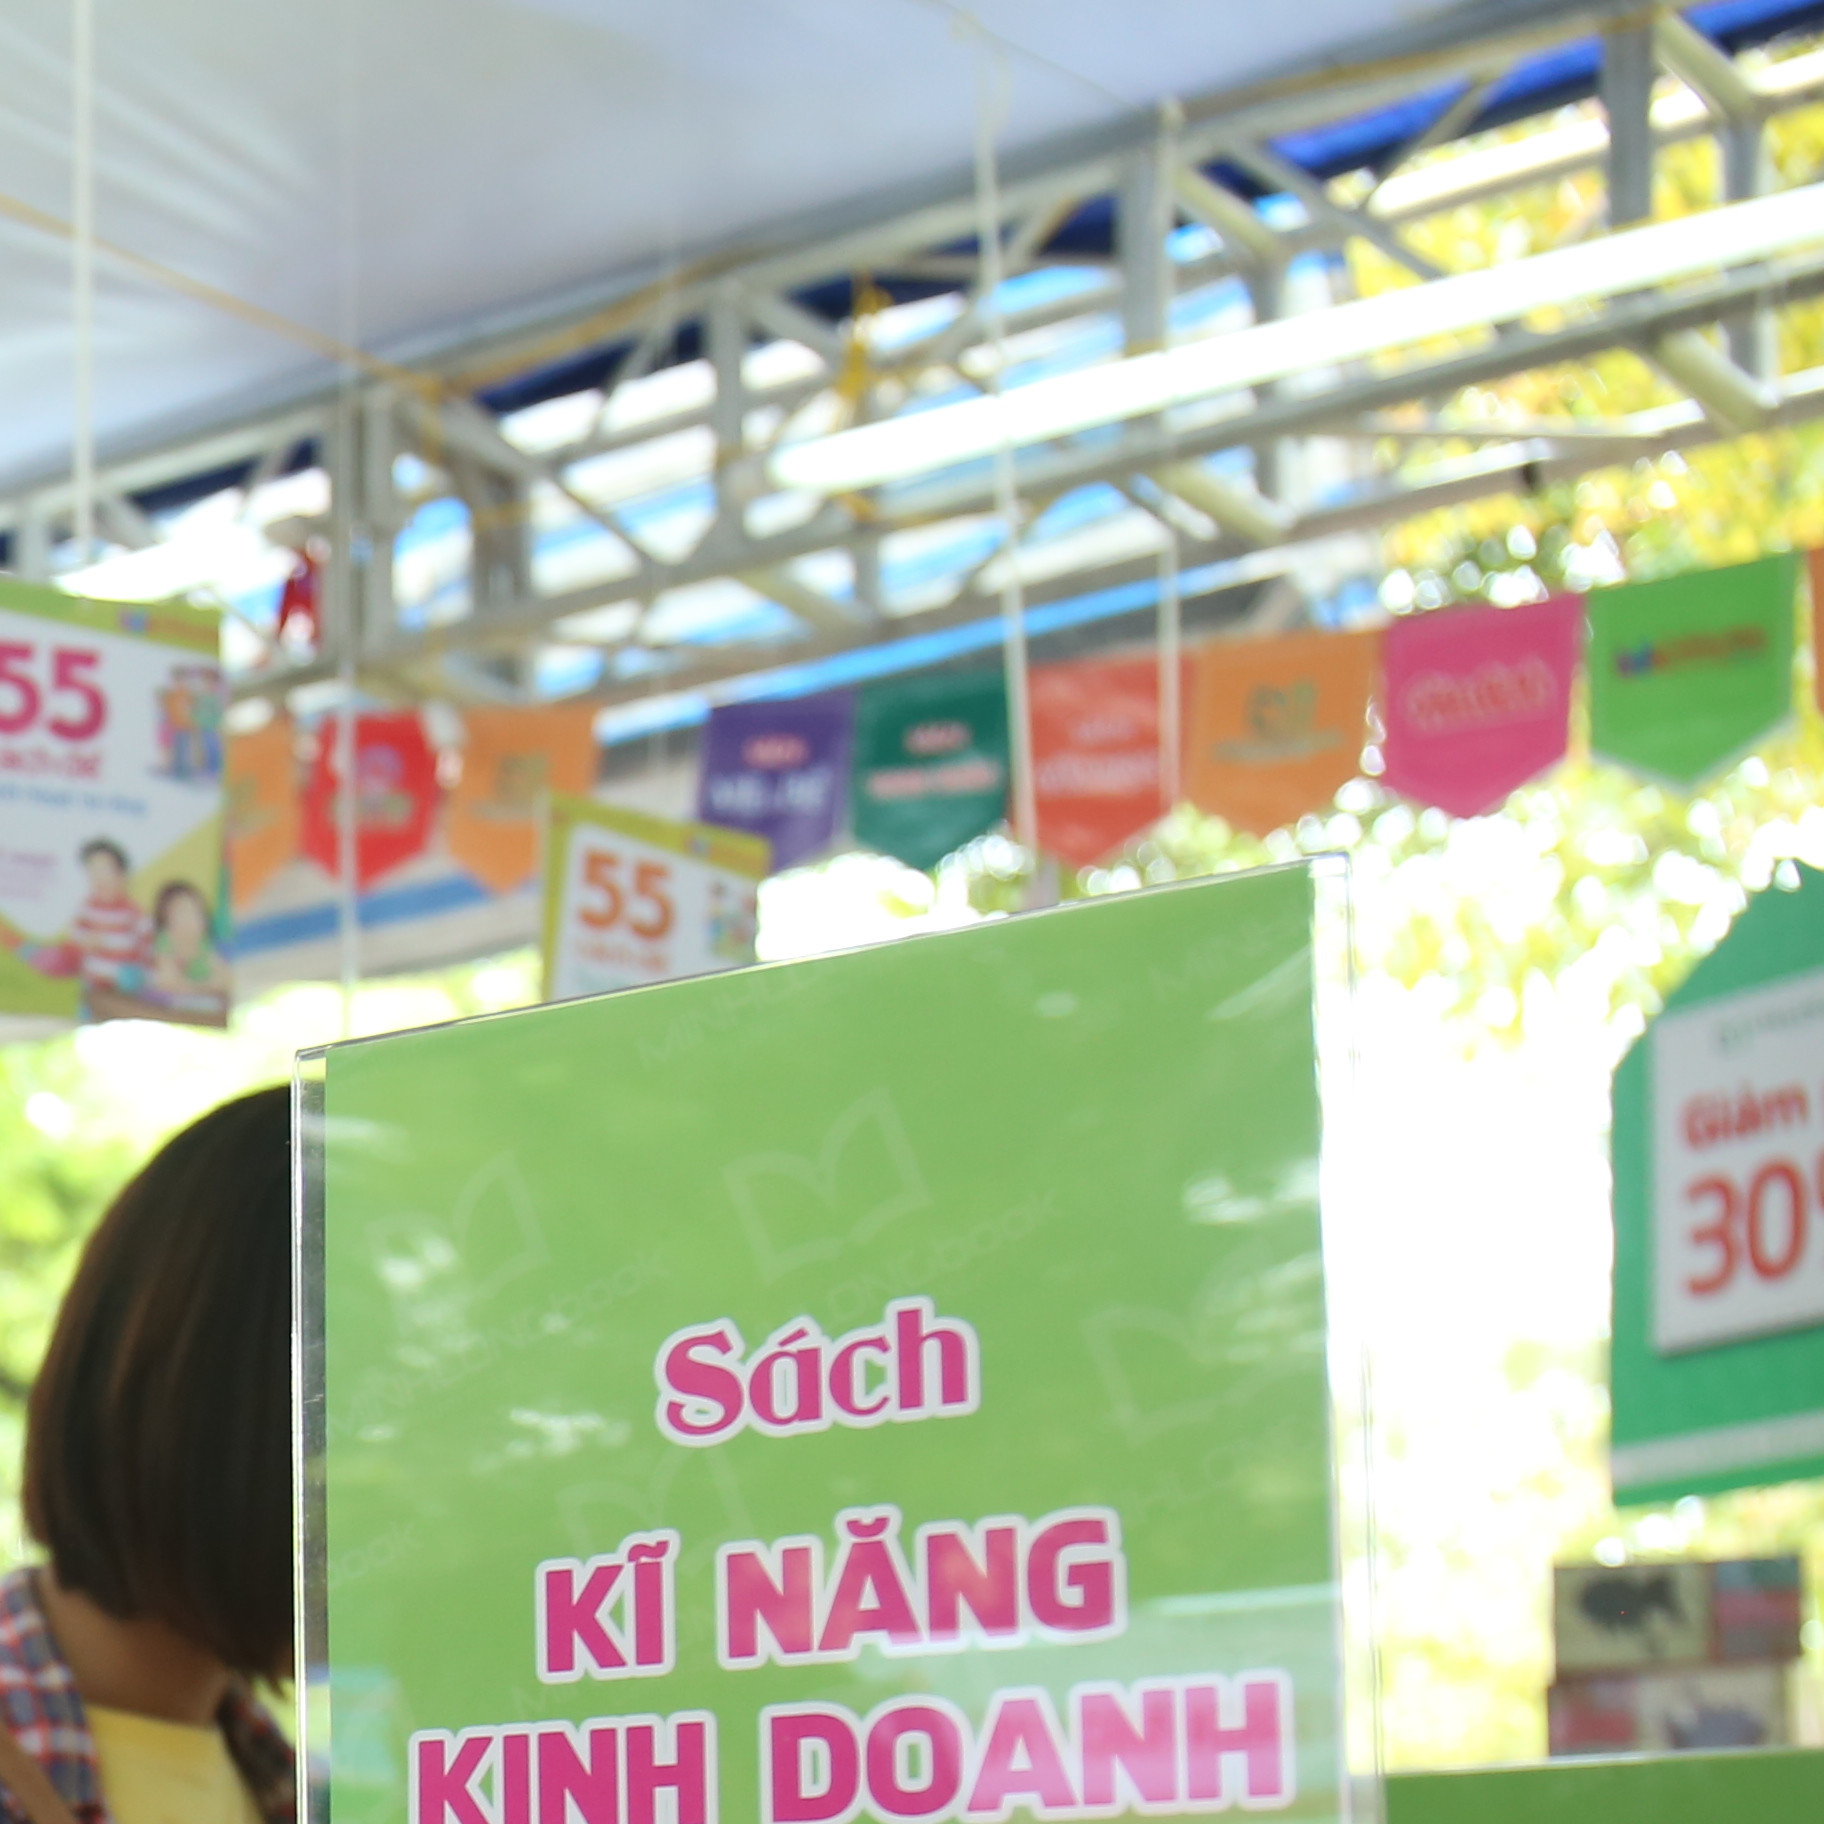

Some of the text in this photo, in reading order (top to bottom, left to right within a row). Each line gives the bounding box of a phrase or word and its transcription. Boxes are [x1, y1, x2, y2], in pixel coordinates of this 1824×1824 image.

[578, 848, 675, 940] 55
[1685, 1155, 1824, 1298] 30
[663, 1306, 969, 1437] Sách
[543, 1514, 1117, 1673] KĨ NĂNG
[769, 1682, 1284, 1824] DOANH
